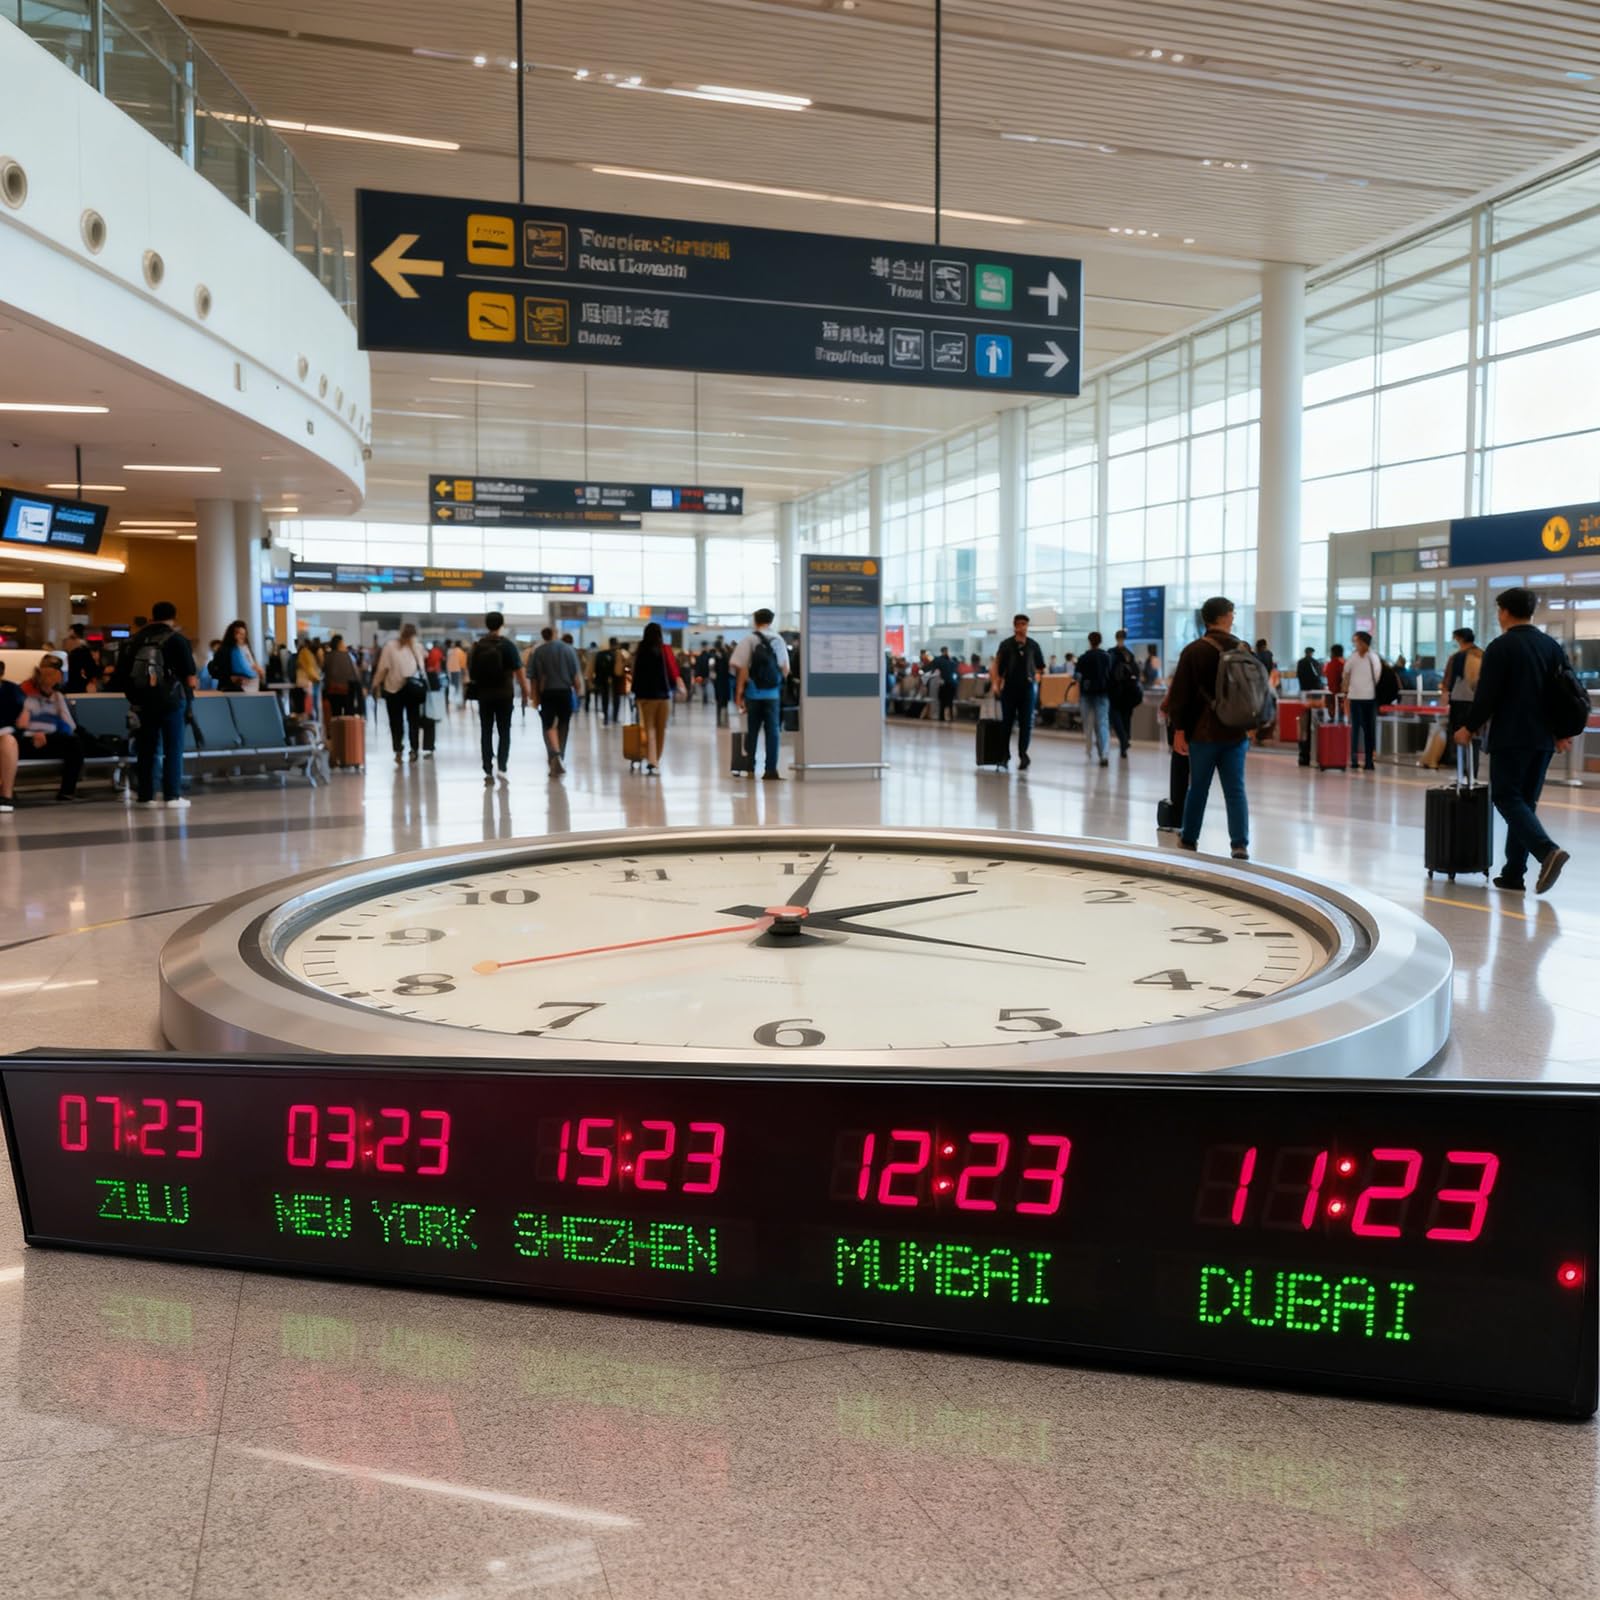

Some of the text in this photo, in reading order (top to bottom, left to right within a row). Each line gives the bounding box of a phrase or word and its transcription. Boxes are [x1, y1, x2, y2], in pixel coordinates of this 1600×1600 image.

[461, 888, 541, 906] 10
[1083, 888, 1137, 904] 2
[381, 927, 447, 946] 9
[1168, 926, 1230, 945] 3
[392, 973, 457, 997] 8
[1133, 968, 1203, 991] 4
[537, 1001, 606, 1030] 7
[753, 1018, 826, 1048] 6
[994, 1007, 1064, 1034] 5
[60, 1094, 204, 1159] 07:23
[287, 1104, 452, 1176] 03:23
[556, 1117, 726, 1194] 15:23
[857, 1129, 1072, 1215] 12:23
[95, 1178, 190, 1225] ZULU
[1230, 1147, 1500, 1242] 11:23
[274, 1192, 478, 1250] NEW YORK
[513, 1212, 719, 1275] SHEZHEN
[835, 1236, 1053, 1305] MUMBAI
[1199, 1266, 1415, 1342] DUBAI
